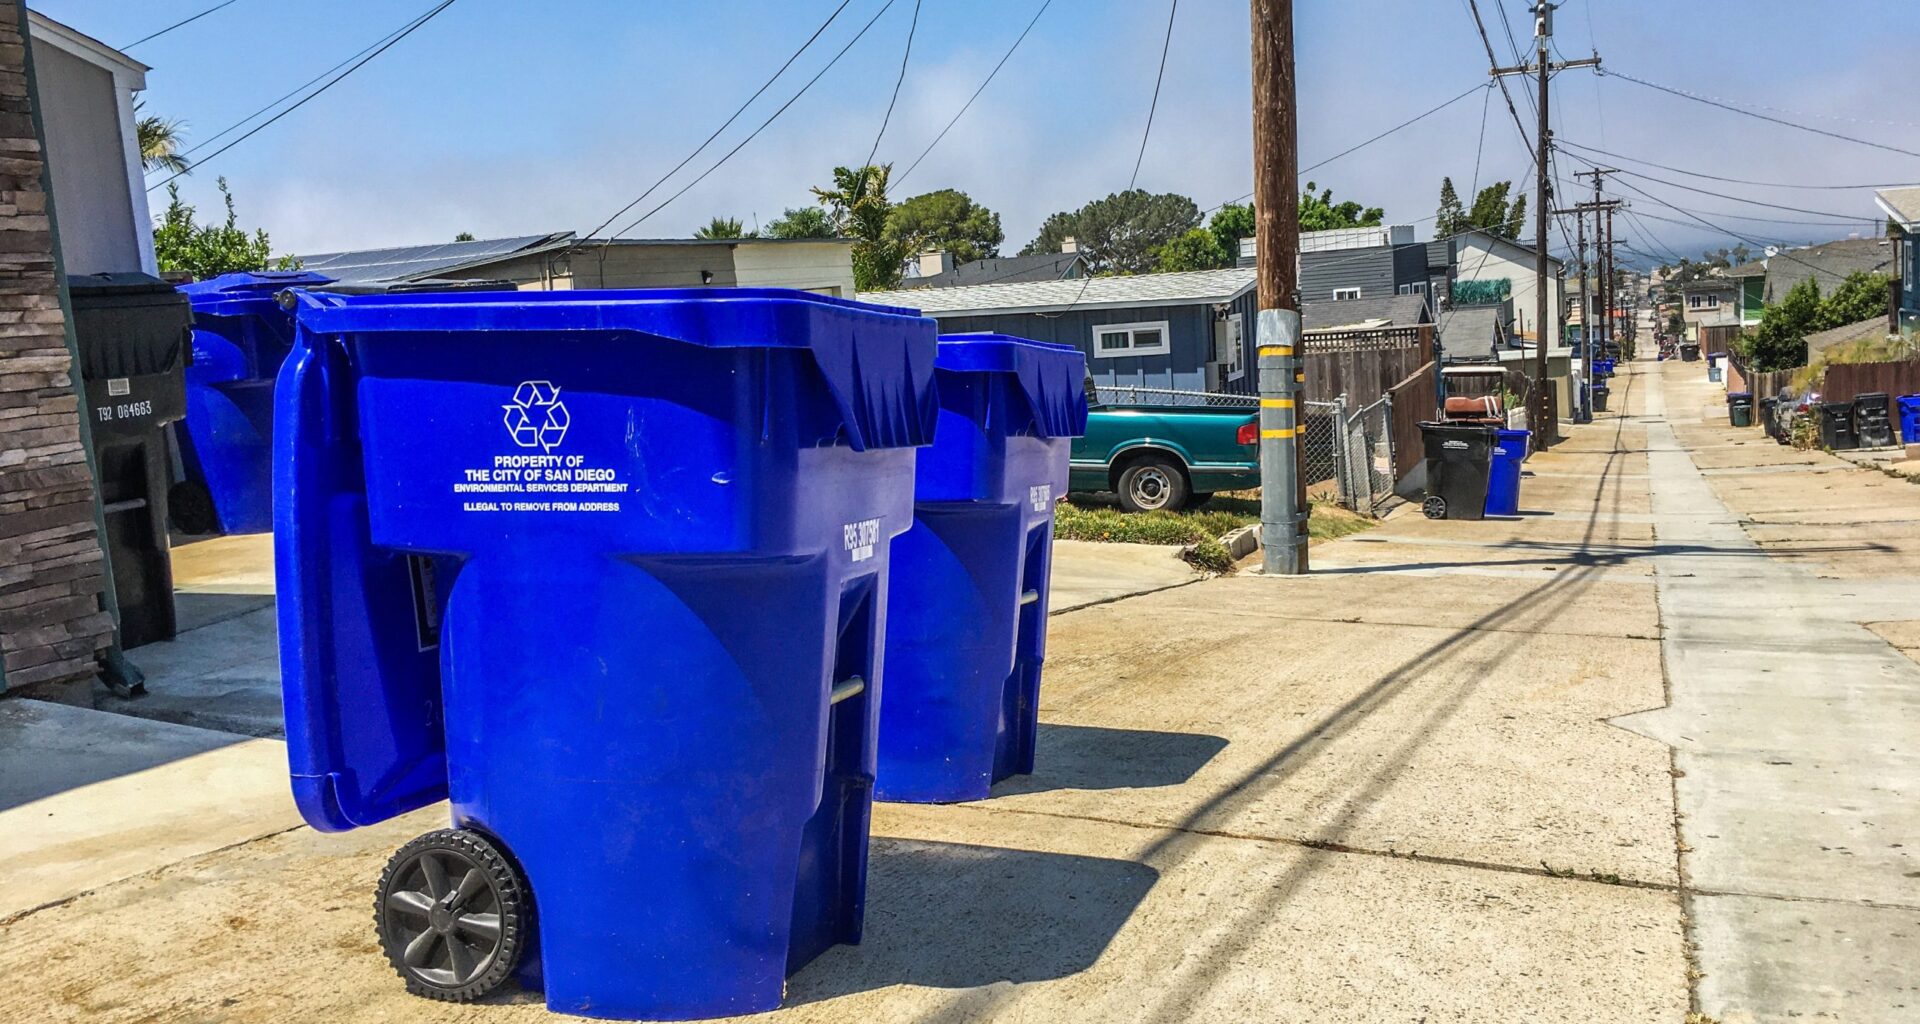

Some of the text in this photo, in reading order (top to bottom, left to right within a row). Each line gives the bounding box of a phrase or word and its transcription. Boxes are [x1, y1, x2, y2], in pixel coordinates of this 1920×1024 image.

[97, 400, 152, 422] T92 064663
[495, 455, 584, 468] PROPERTY OF
[465, 469, 616, 482] THE CITY OF SAN DIEGO
[454, 483, 628, 493] ENVIRONMENTAL SERVICES DEPARTMENT
[463, 502, 499, 511] ILLEGAL
[500, 502, 512, 511] TO
[514, 502, 550, 511] REMOVE
[552, 502, 577, 511] FROM
[844, 523, 857, 551] R95
